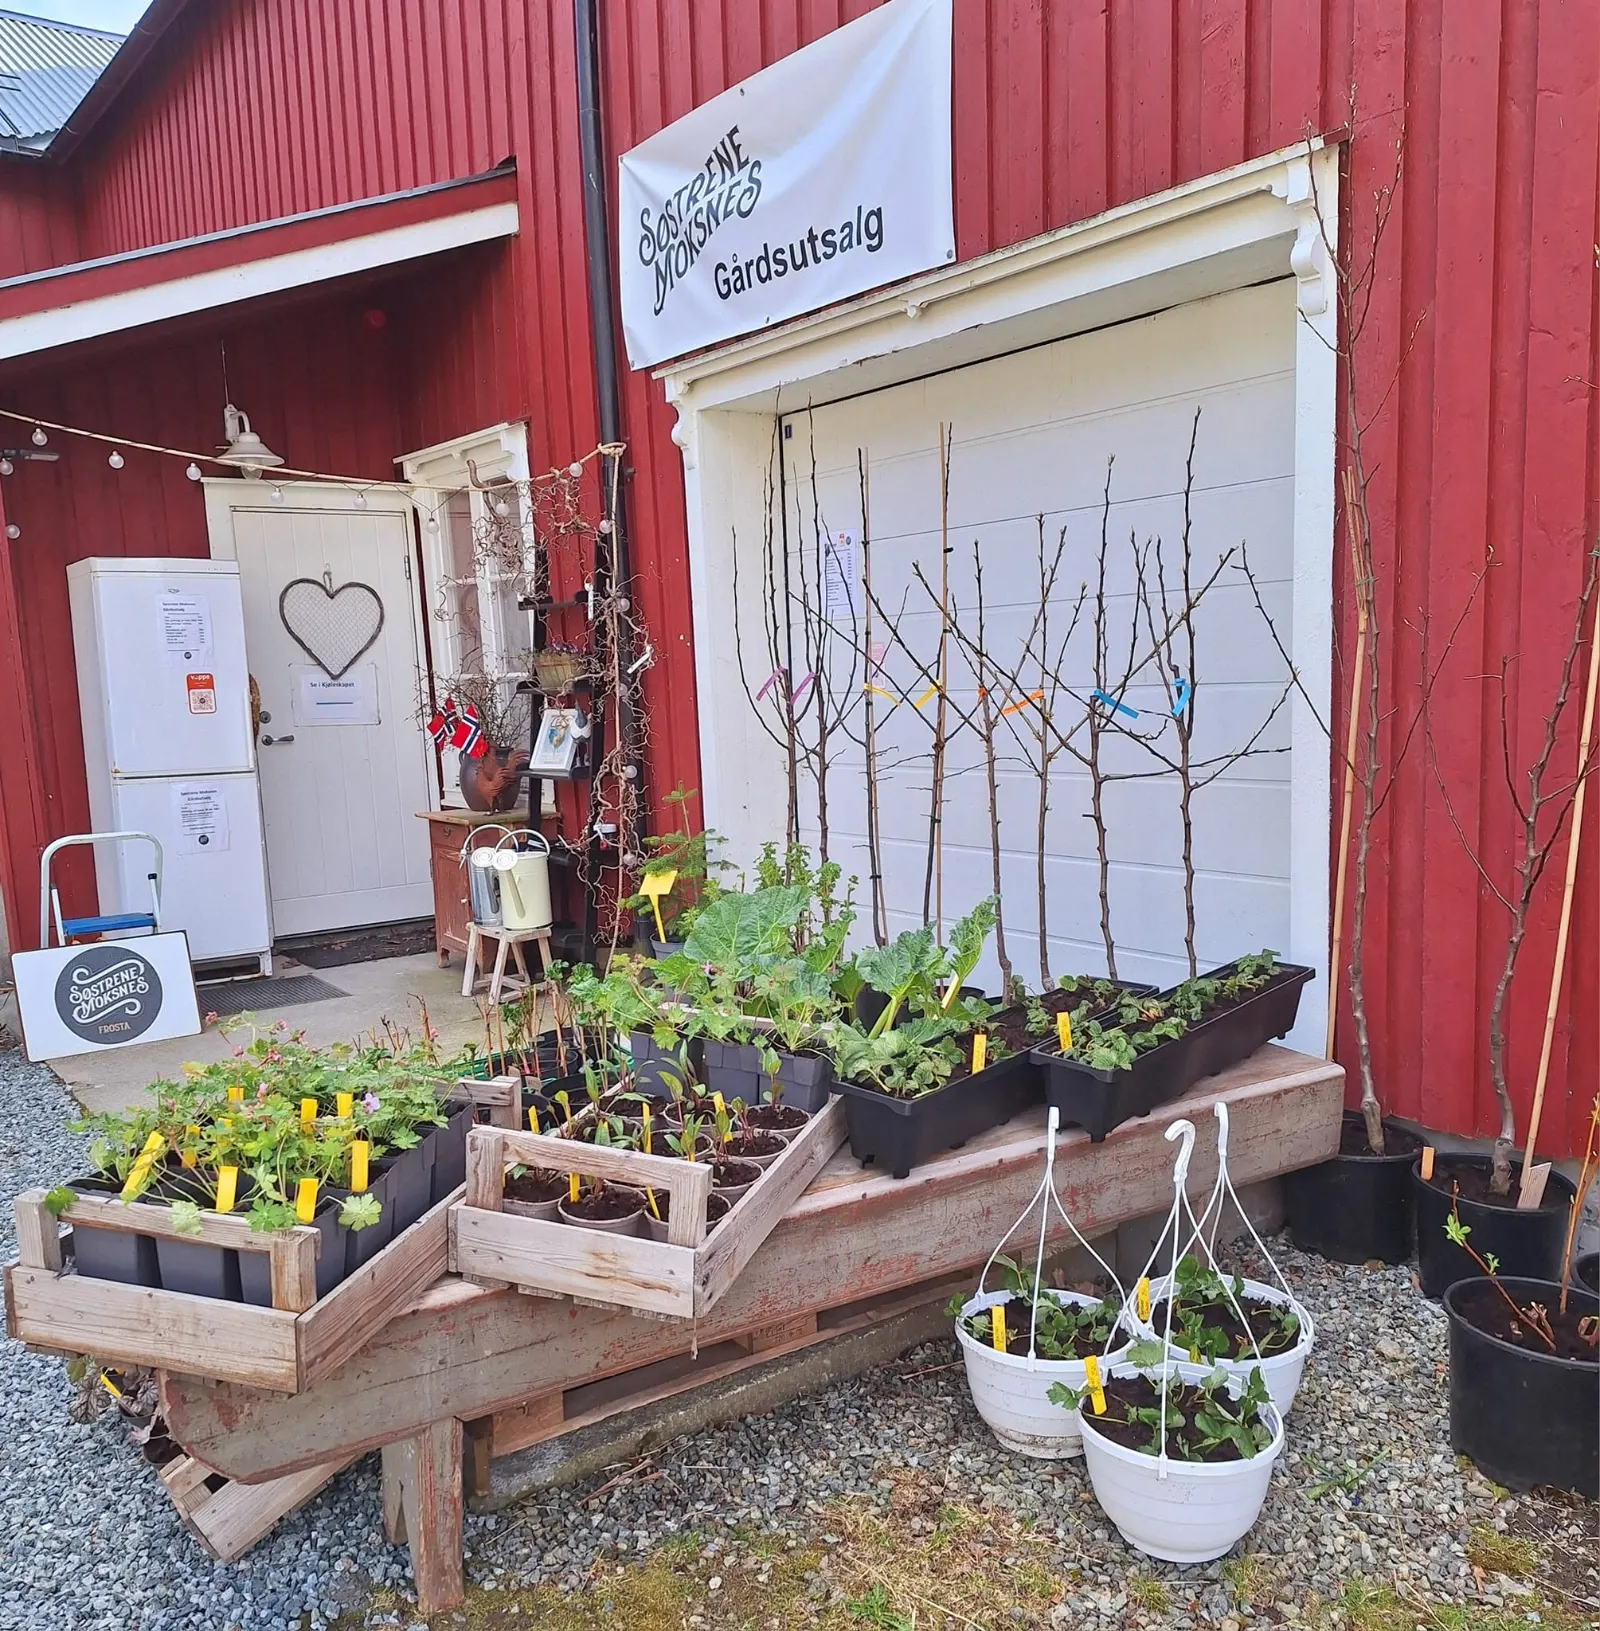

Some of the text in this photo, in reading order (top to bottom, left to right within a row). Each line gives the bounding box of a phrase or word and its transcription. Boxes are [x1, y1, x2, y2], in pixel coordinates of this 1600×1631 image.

[639, 125, 751, 266] SØSTRENE
[653, 160, 763, 316] MOKSNES
[714, 205, 884, 300] Gårdsutsalg
[69, 967, 139, 1004] SØSTRENE
[78, 976, 150, 1018] MOKSNES
[98, 1022, 131, 1034] FROSTA
